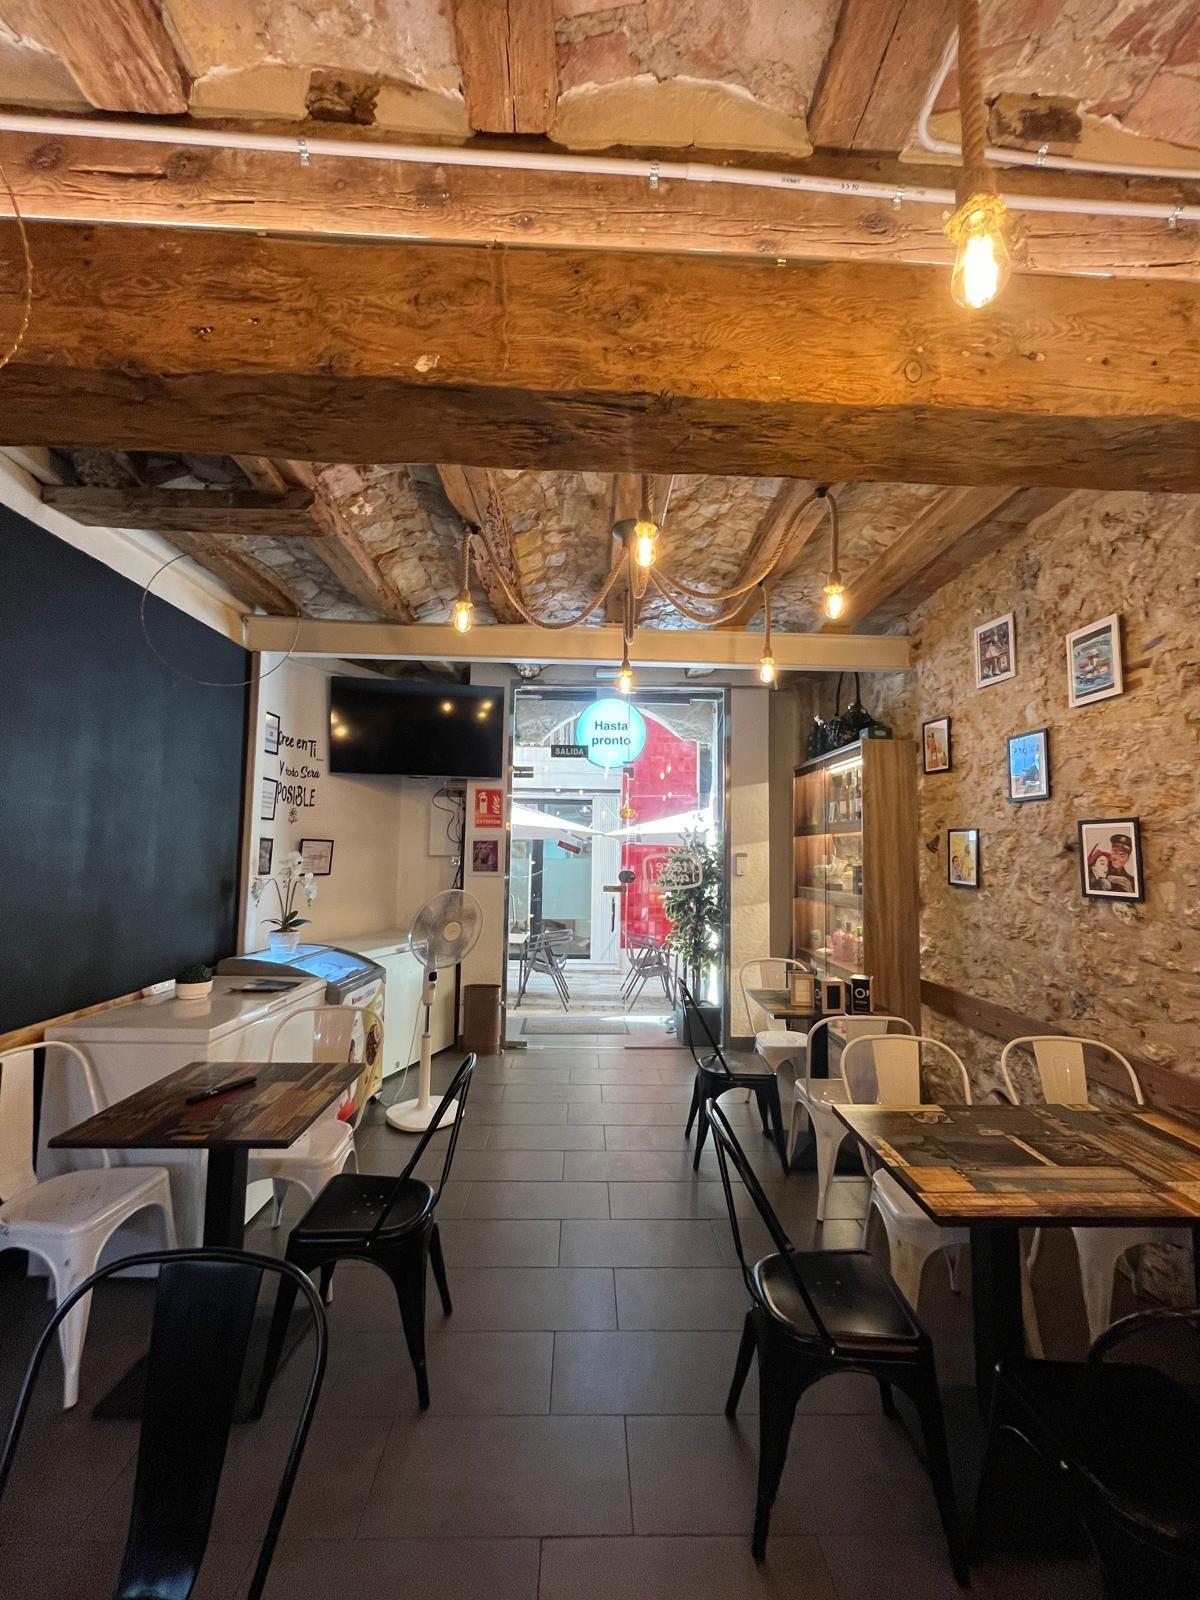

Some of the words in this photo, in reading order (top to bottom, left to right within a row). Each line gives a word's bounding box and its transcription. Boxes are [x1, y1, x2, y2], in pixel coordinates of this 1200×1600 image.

[594, 720, 628, 731] Hasta
[278, 731, 294, 747] Cree
[297, 739, 307, 750] en
[592, 736, 631, 747] pronto
[555, 748, 584, 756] SALIDA
[286, 768, 299, 778] todo
[276, 782, 316, 806] POSIBLE
